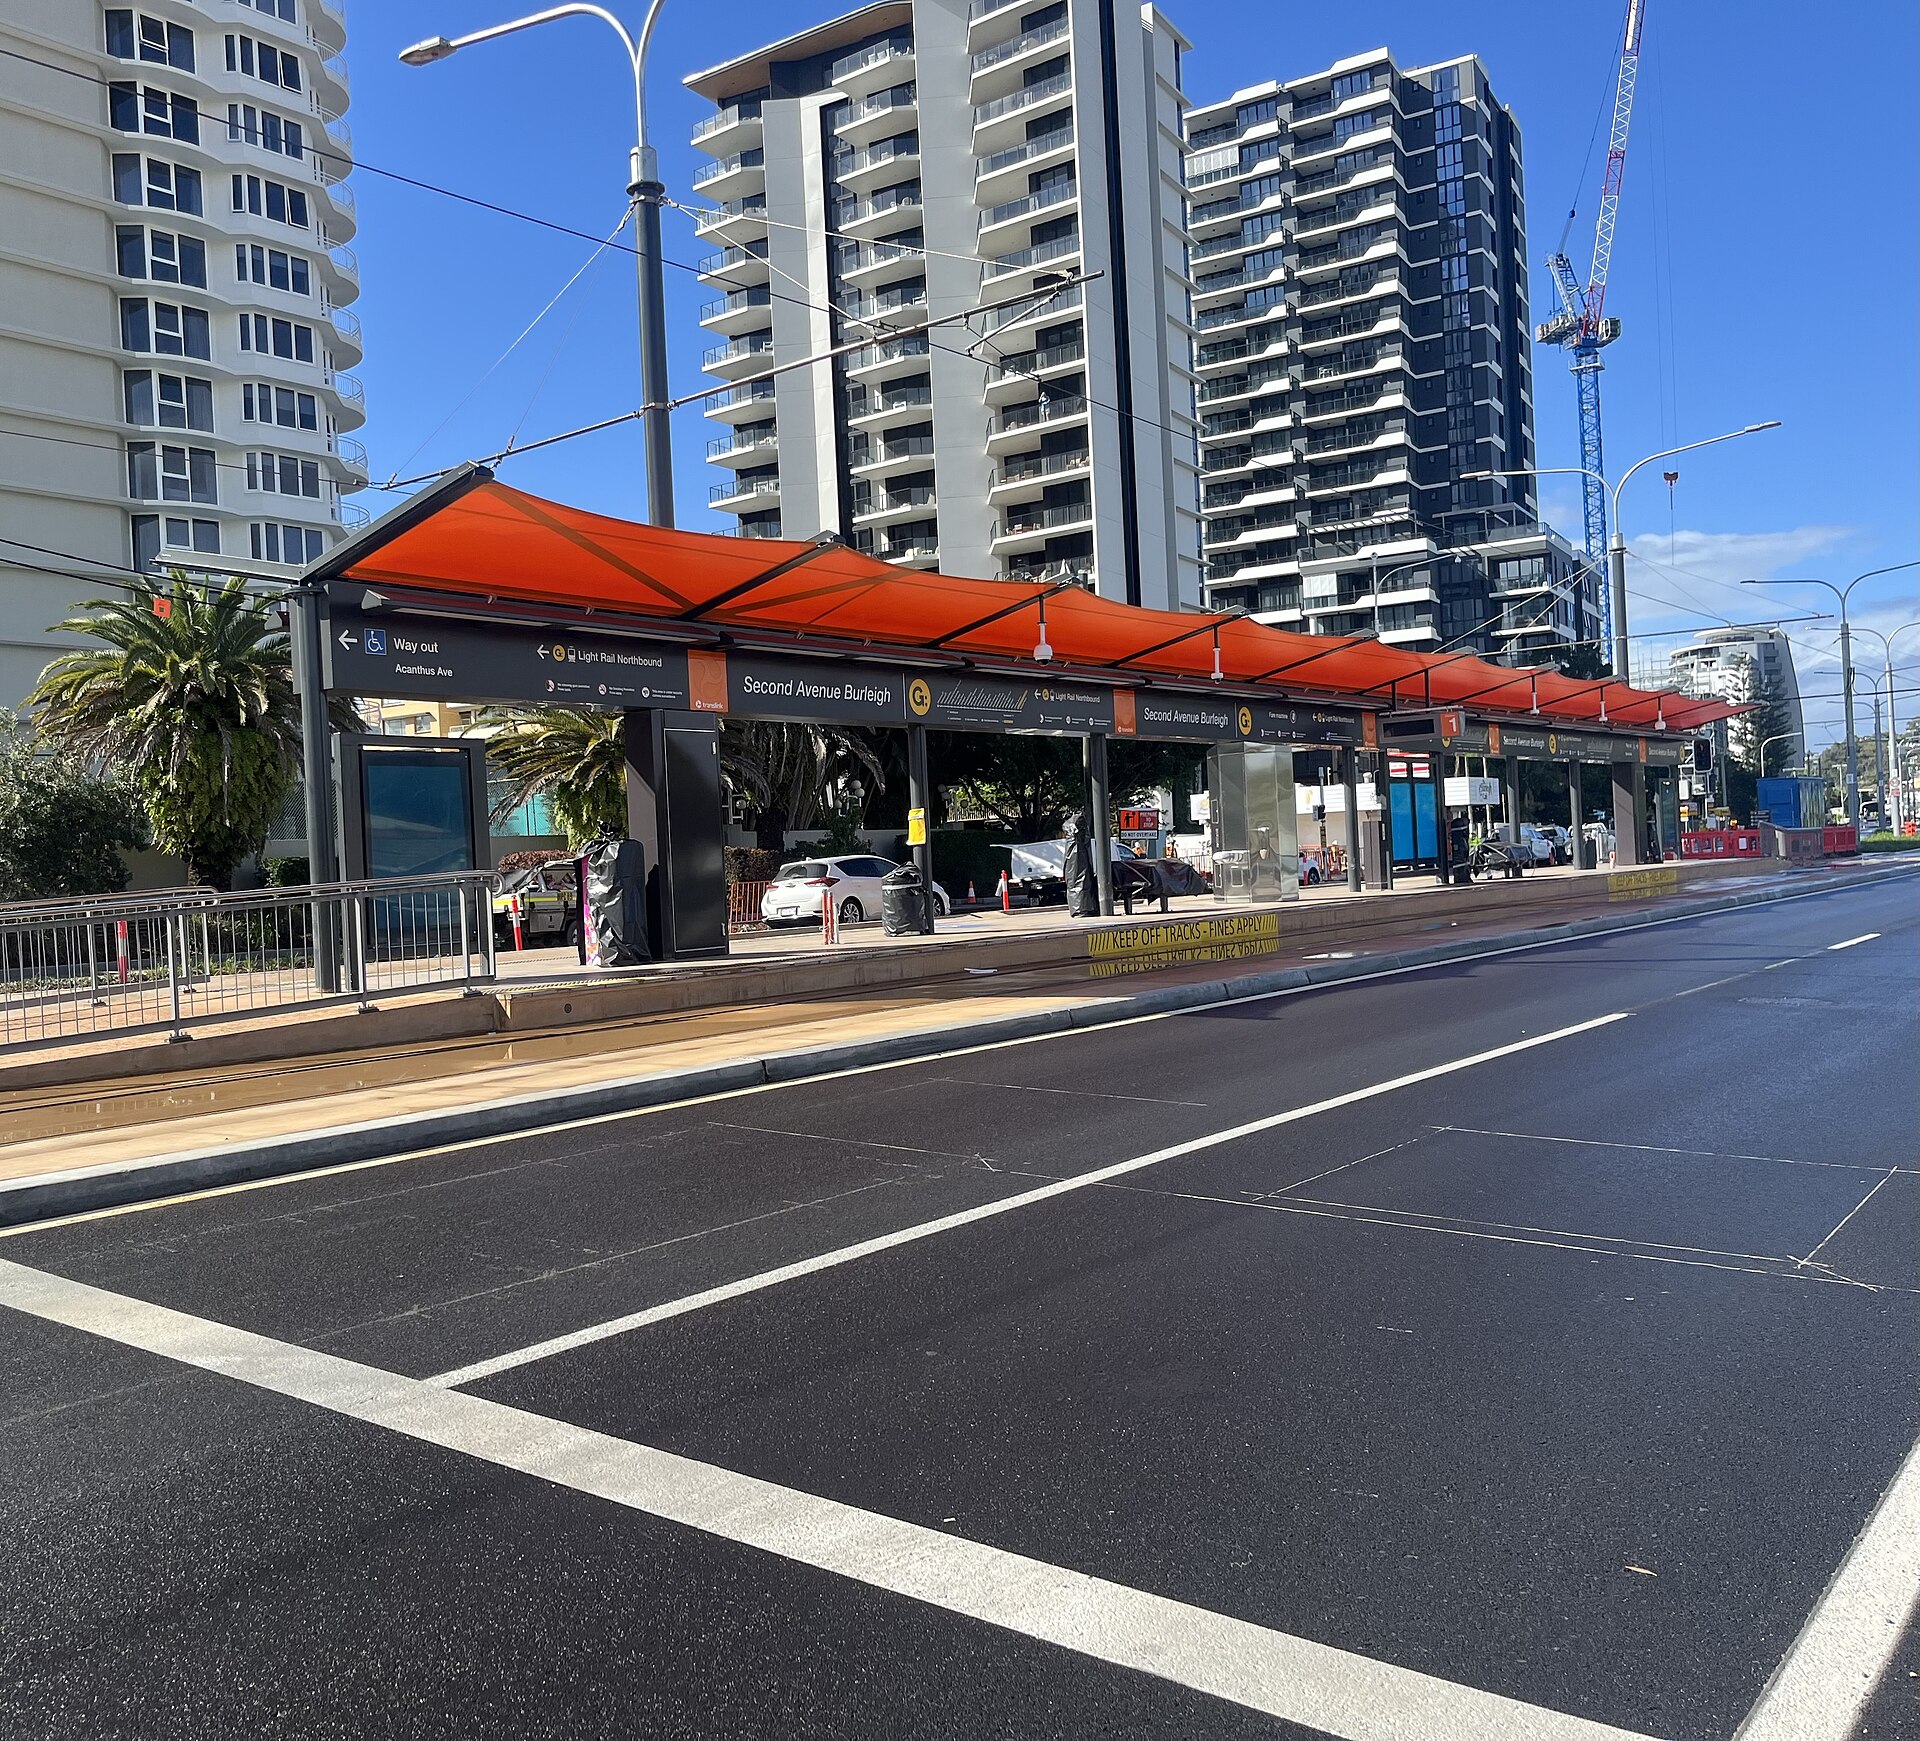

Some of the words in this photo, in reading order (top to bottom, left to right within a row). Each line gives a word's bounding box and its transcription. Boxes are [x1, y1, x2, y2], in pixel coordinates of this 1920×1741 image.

[393, 637, 418, 654] Way
[420, 641, 439, 653] out
[578, 651, 599, 663] Light
[601, 653, 616, 664] Rail
[617, 655, 662, 668] Northbound
[395, 663, 436, 676] Acanthus
[437, 666, 453, 677] Ave
[743, 675, 793, 696] Second
[795, 680, 842, 700] Avenue
[843, 684, 891, 706] Burleigh
[1143, 706, 1173, 722] Second
[1172, 709, 1200, 724] Avenue
[1200, 711, 1229, 728] Burleigh
[1448, 717, 1457, 732] 1
[1112, 929, 1139, 949] KEEP
[1141, 926, 1161, 946] OFF
[1162, 921, 1201, 943] TRACKS
[1209, 919, 1235, 938] FINES
[1236, 915, 1262, 934] APPLY
